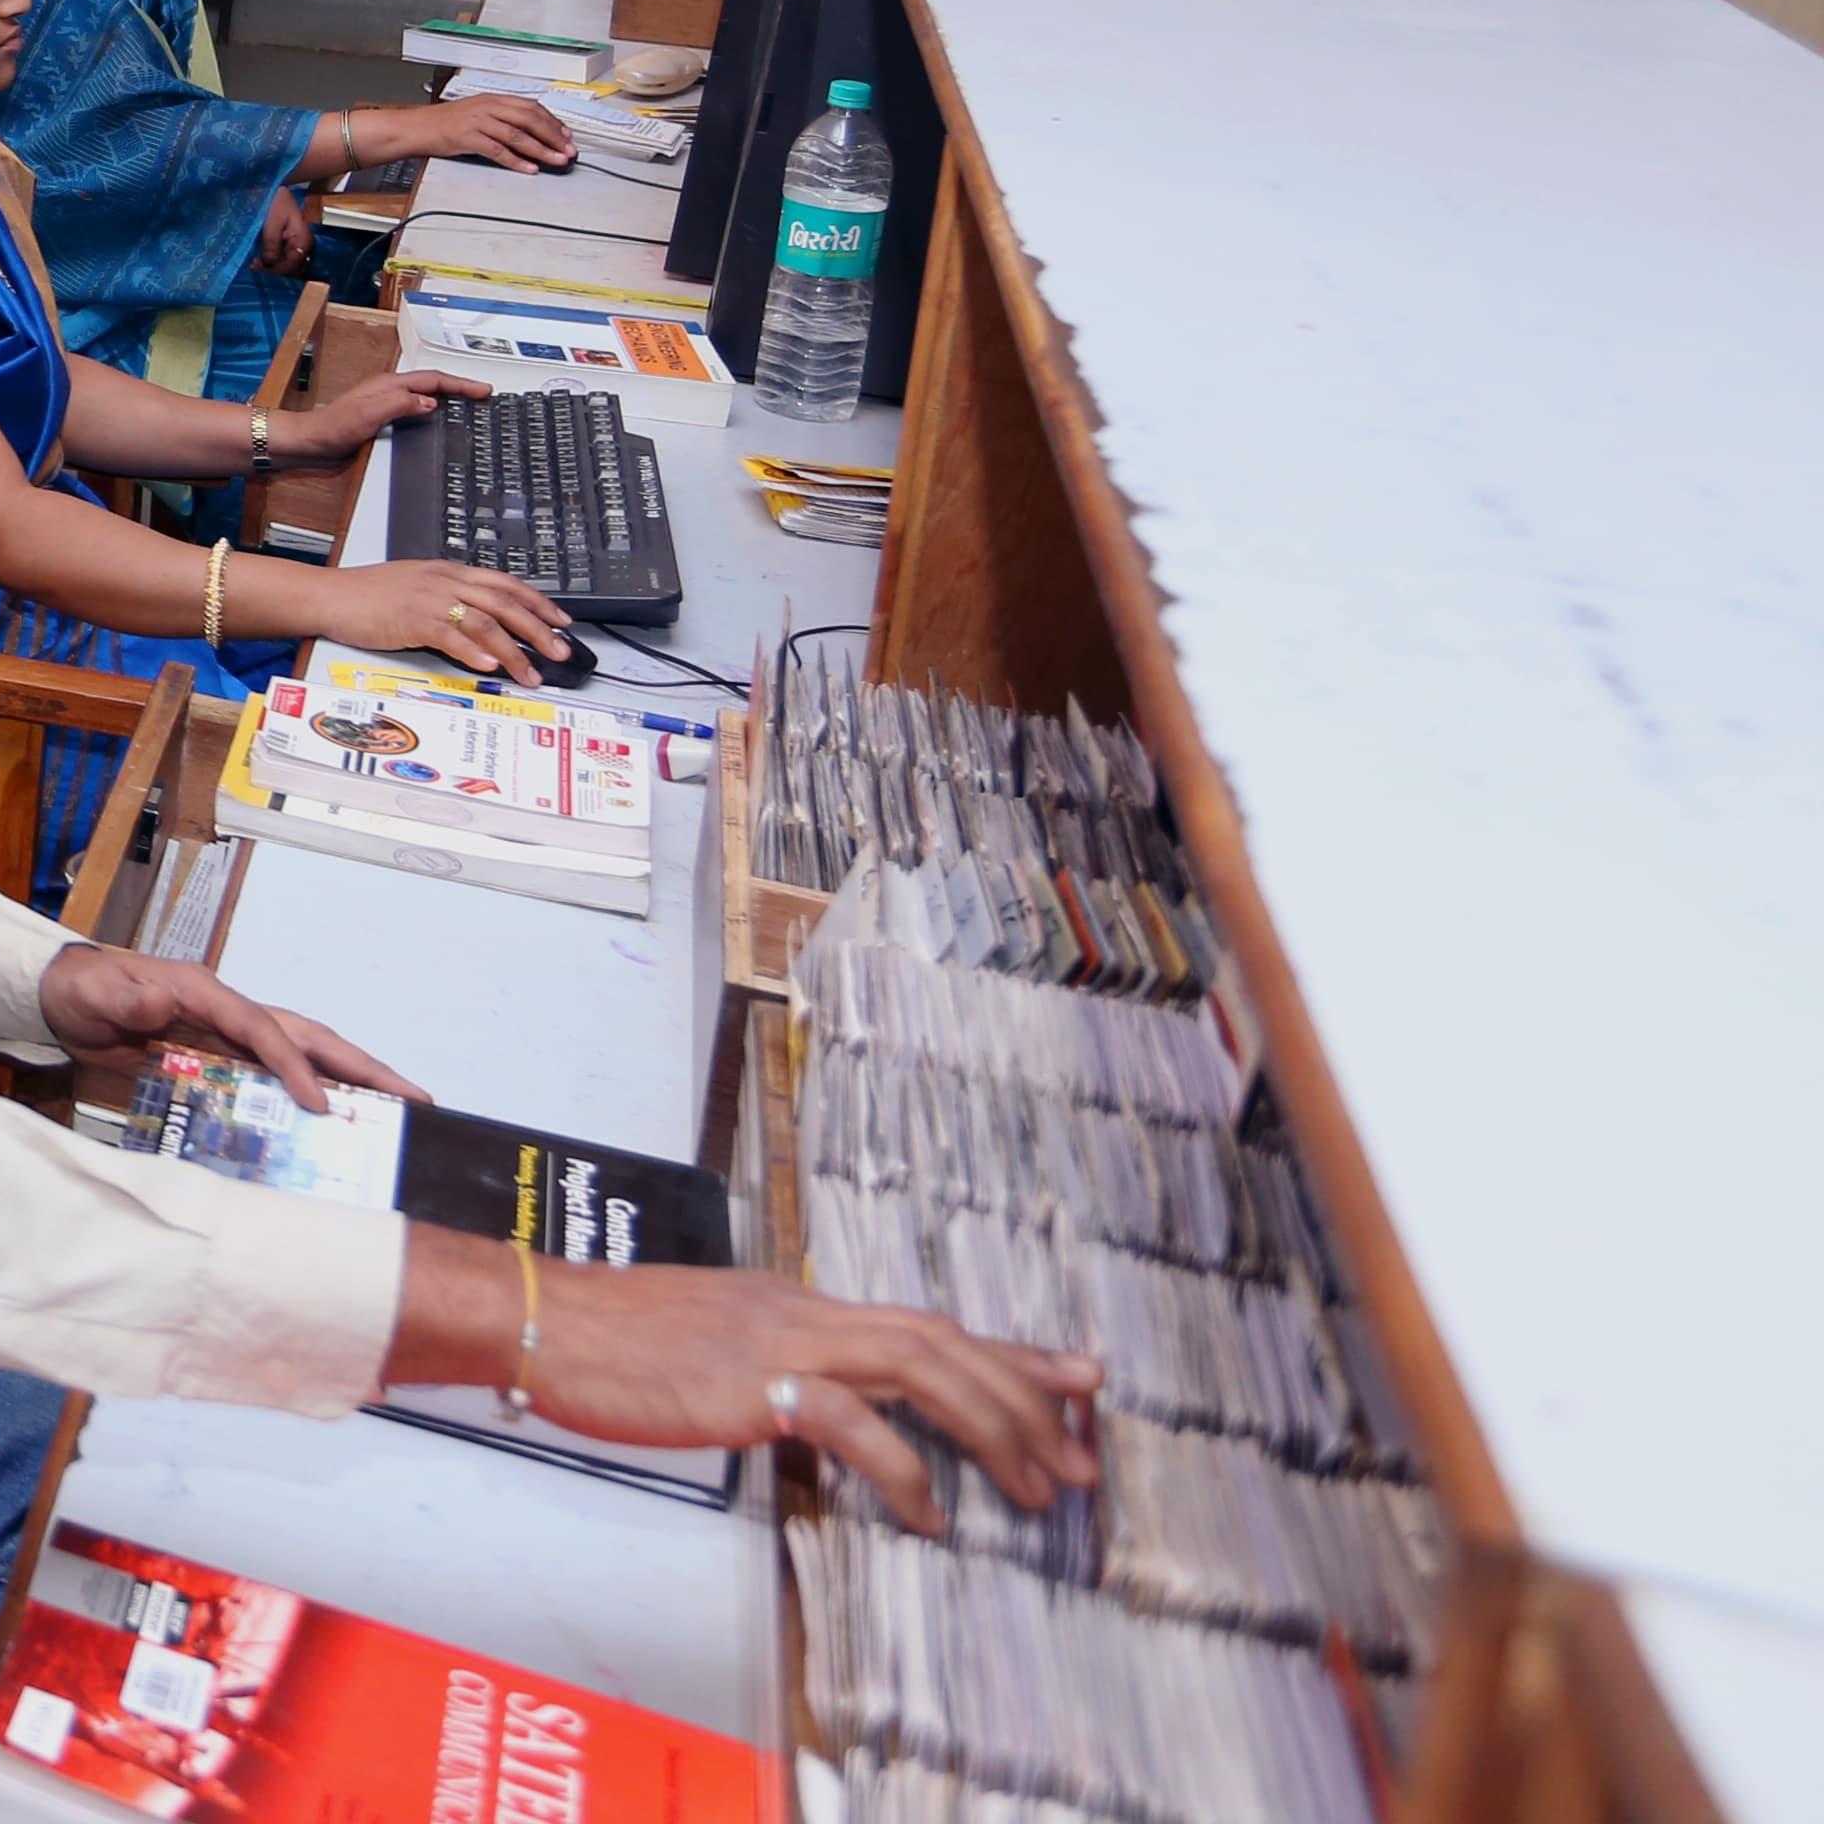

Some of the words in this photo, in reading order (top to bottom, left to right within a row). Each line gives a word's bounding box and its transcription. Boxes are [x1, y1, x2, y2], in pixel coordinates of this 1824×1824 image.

[621, 320, 658, 364] MECHANICS
[647, 322, 688, 371] ENGINEERING
[167, 1116, 188, 1126] K
[170, 1104, 191, 1116] K
[159, 1125, 186, 1159] CHIT
[559, 1157, 598, 1216] Project
